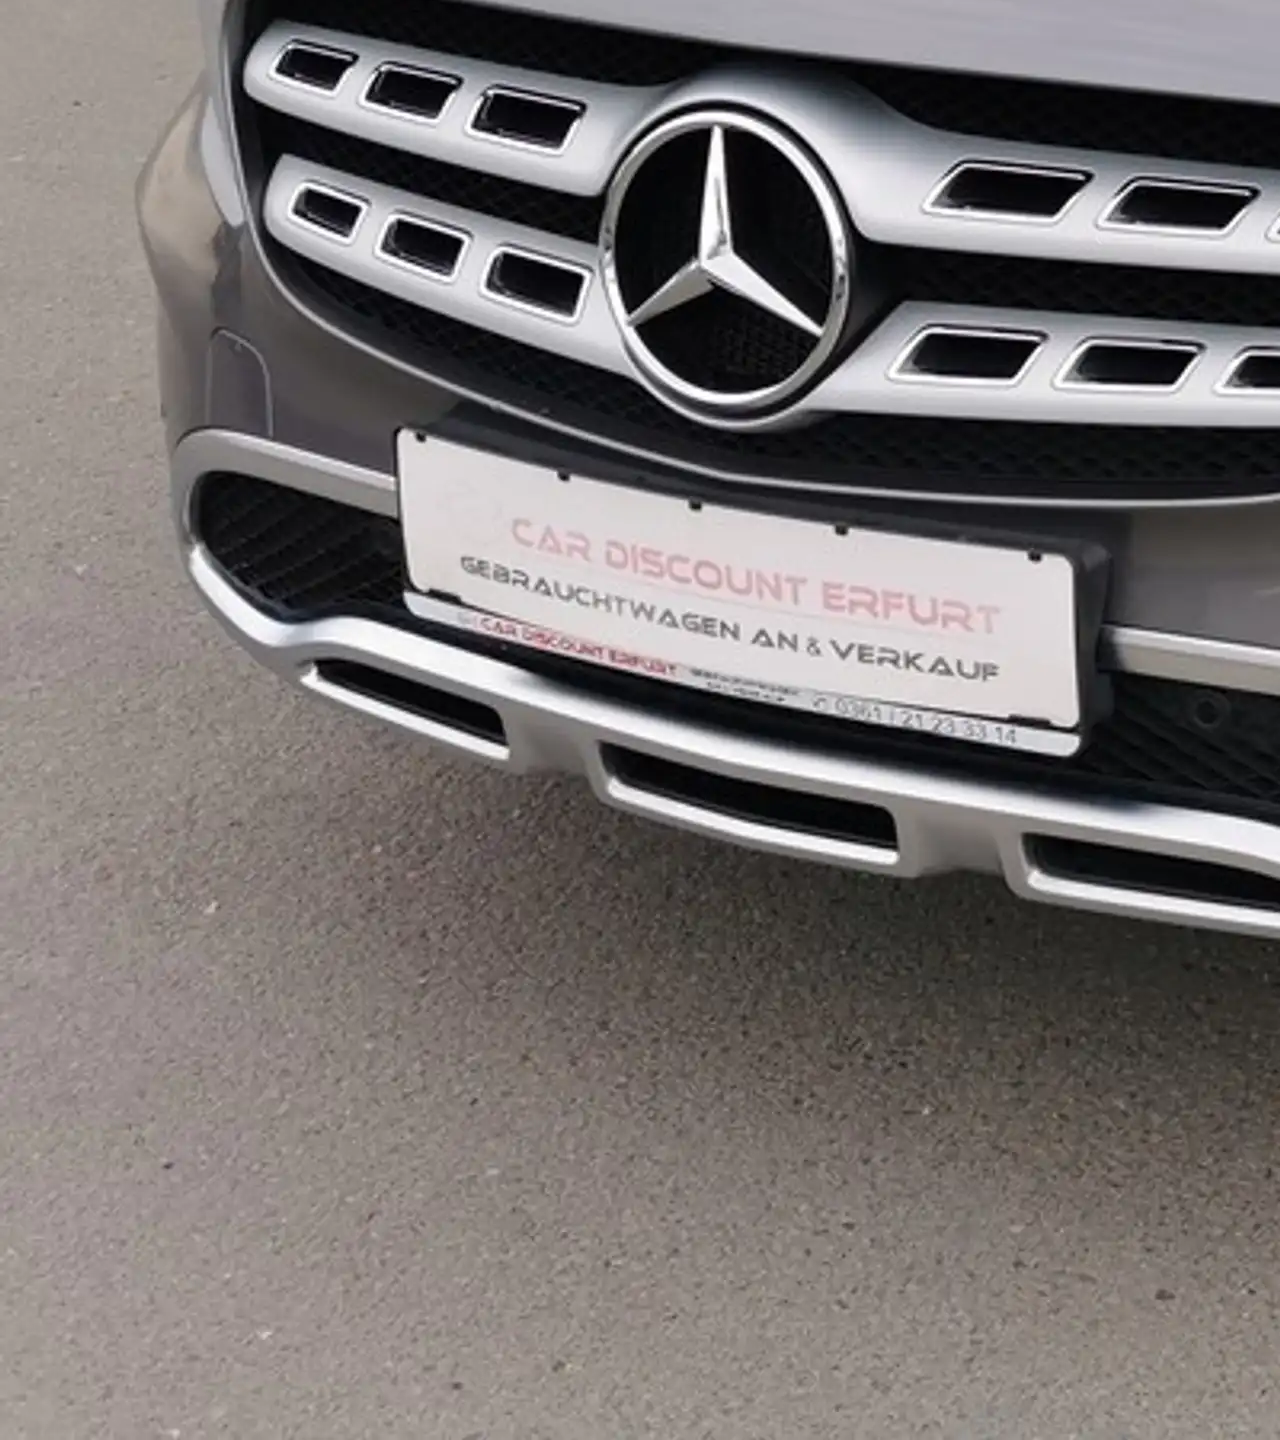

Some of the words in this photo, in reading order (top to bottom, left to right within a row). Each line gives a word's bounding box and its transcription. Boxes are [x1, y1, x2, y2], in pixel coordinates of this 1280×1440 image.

[511, 517, 592, 562] CAR
[604, 540, 808, 606] DISCOUNT
[821, 580, 1001, 634] ERFURT
[460, 555, 741, 642] GEBRAUCHTWAGEN
[751, 627, 798, 653] AN
[806, 636, 822, 657] &
[829, 639, 1000, 682] VERKAUF
[480, 617, 516, 637] CAR
[521, 627, 605, 661] DISCOUNT
[901, 710, 923, 728] 21
[995, 726, 1017, 744] 14
